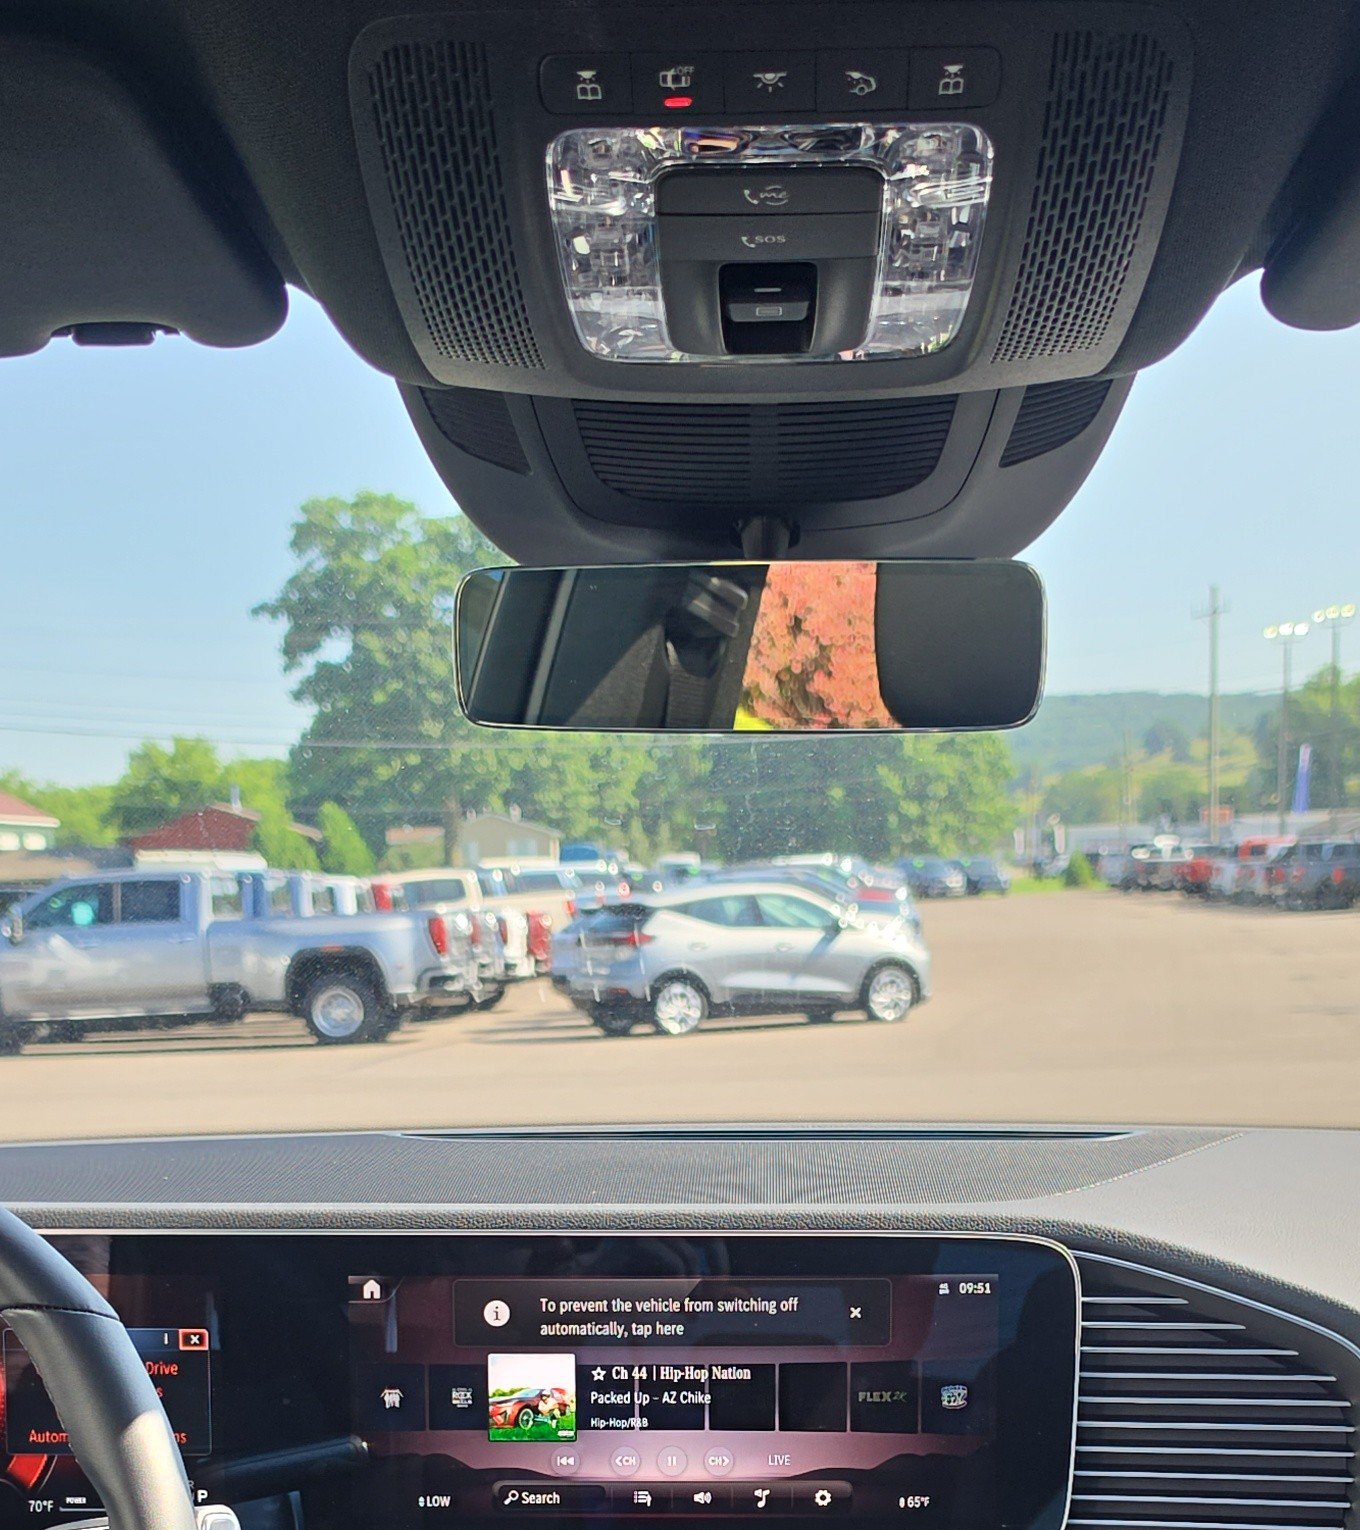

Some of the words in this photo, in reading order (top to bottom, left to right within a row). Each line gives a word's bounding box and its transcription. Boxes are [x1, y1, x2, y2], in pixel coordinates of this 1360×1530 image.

[754, 235, 786, 243] SOS
[959, 1282, 991, 1294] 09:51
[540, 1298, 557, 1313] To
[559, 1299, 608, 1315] prevent
[611, 1298, 632, 1313] the
[635, 1298, 681, 1313] vehicle
[684, 1298, 714, 1313] from
[717, 1298, 777, 1315] switching
[780, 1297, 799, 1312] off
[540, 1321, 629, 1338] automatically,
[631, 1322, 653, 1338] tap
[656, 1322, 684, 1336] here
[612, 1366, 629, 1380] Ch
[632, 1366, 648, 1380] 44
[660, 1366, 710, 1382] Hip-Hop
[712, 1366, 752, 1380] Nation
[590, 1391, 631, 1405] Packed
[634, 1392, 650, 1407] Up
[662, 1391, 677, 1405] AZ
[680, 1391, 712, 1405] Chike
[590, 1417, 649, 1430] Hip-Hop/R&B
[768, 1455, 791, 1466] LIVE
[197, 1489, 209, 1503] P
[426, 1496, 451, 1508] LOW
[521, 1492, 561, 1505] Search
[27, 1500, 54, 1513] 70°F
